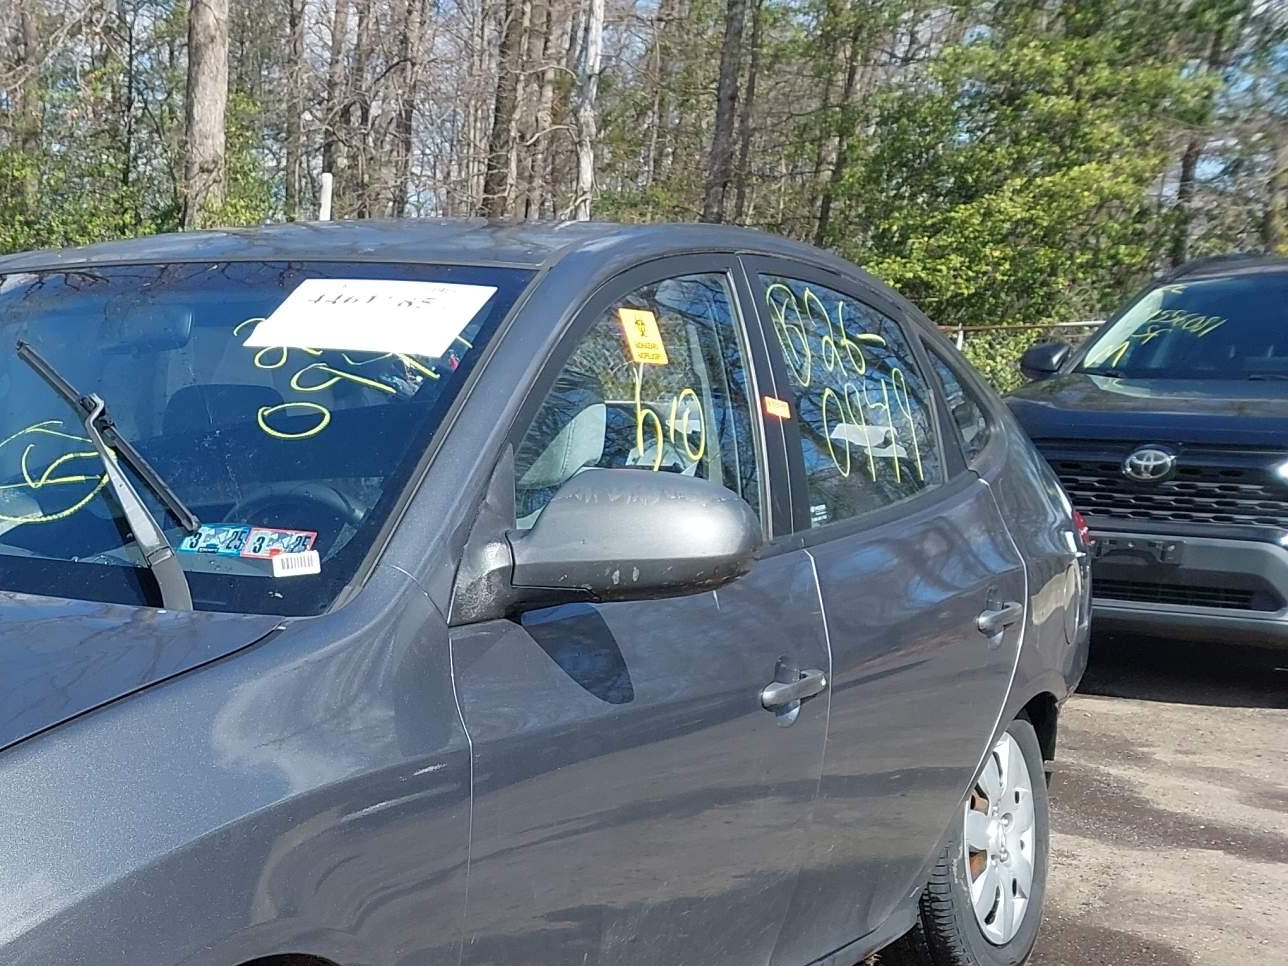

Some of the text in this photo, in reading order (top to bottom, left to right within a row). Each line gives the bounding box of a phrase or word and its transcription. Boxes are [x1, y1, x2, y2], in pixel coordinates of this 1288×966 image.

[189, 532, 202, 549] 3
[226, 530, 247, 550] 25
[252, 536, 266, 553] 3
